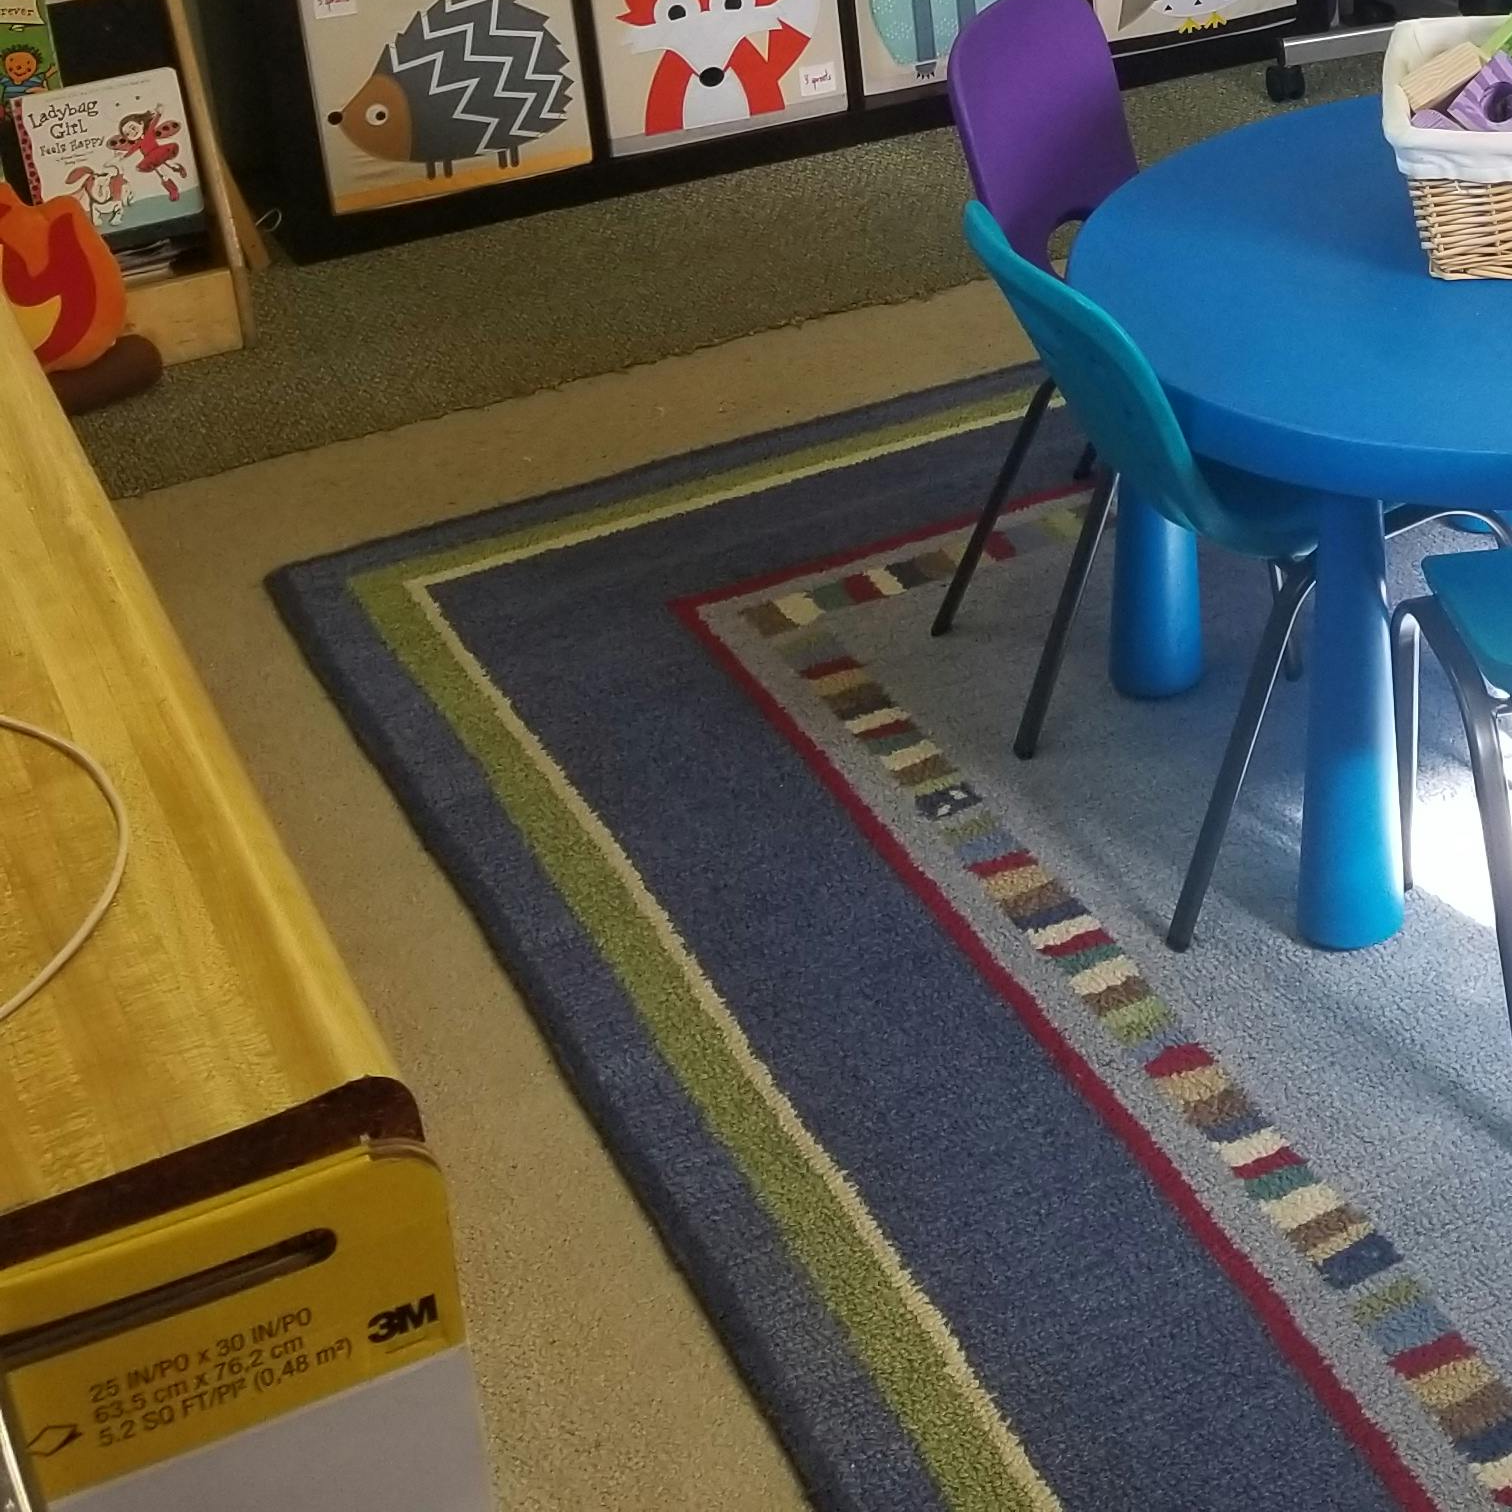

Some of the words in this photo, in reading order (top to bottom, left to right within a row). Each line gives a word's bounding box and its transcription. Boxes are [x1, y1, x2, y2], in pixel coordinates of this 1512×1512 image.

[27, 100, 99, 129] Ladybug
[40, 142, 66, 157] Feels
[69, 136, 105, 153] Happy
[367, 1294, 440, 1344] 3M
[89, 1379, 120, 1403] 25
[128, 1354, 190, 1386] IN/PO
[215, 1333, 246, 1357] 30
[251, 1307, 313, 1346] IN/PO
[154, 1380, 190, 1404] cm
[270, 1336, 305, 1360] cm
[98, 1419, 136, 1448] 5.2
[143, 1403, 175, 1432] SQ
